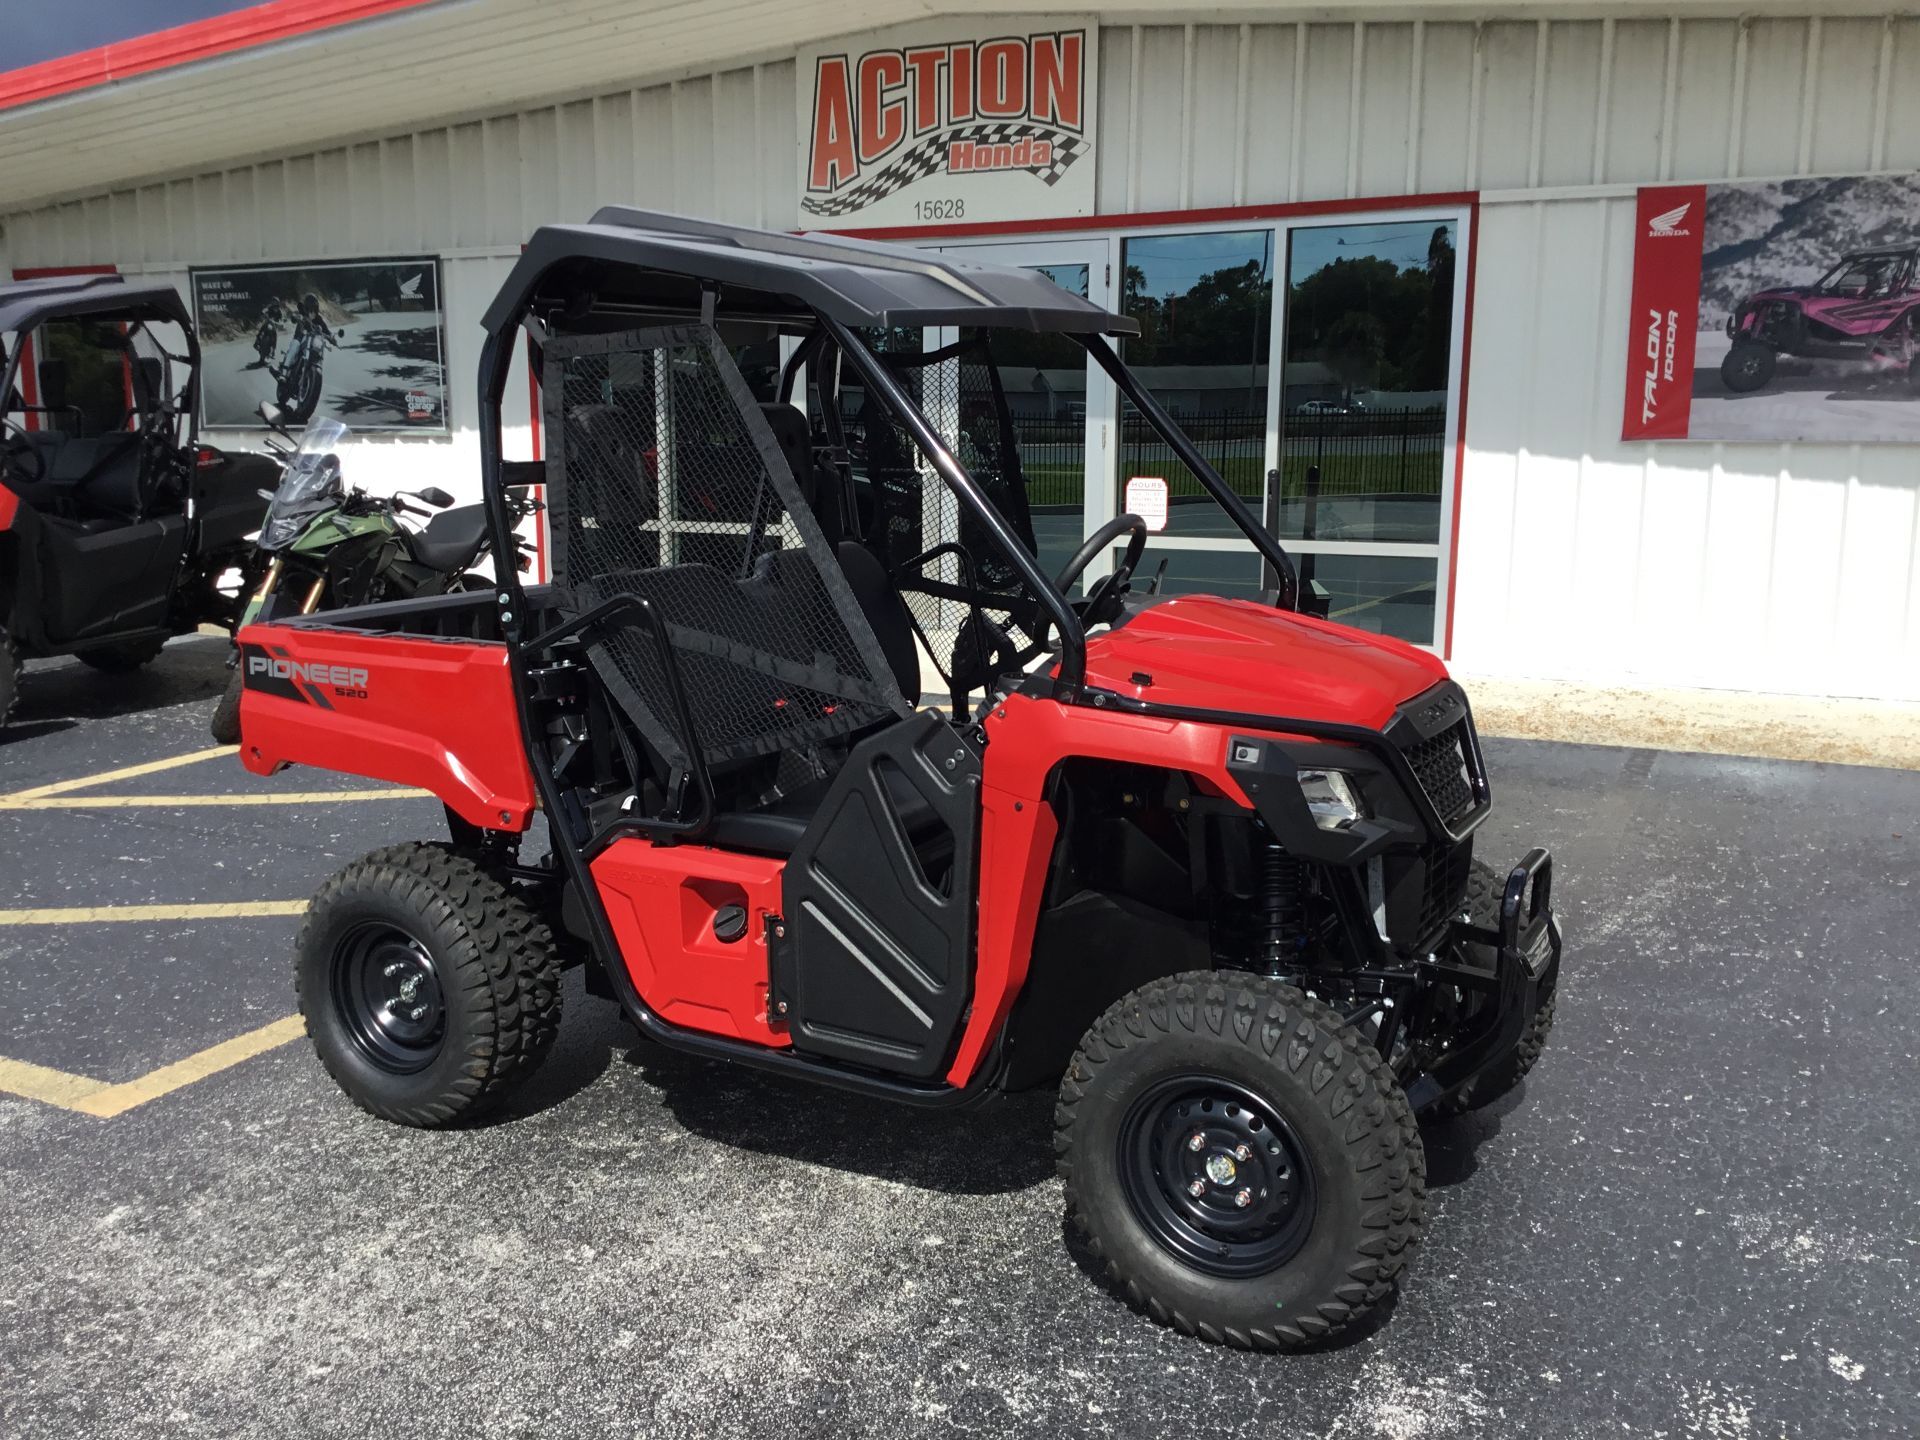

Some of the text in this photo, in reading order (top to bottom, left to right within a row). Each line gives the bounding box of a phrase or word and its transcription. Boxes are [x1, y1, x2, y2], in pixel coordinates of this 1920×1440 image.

[807, 29, 1086, 193] ACTION
[948, 135, 1053, 174] Honda
[914, 199, 965, 220] 15628
[1649, 229, 1690, 237] HONDA
[1664, 310, 1678, 382] 1000R
[1642, 309, 1661, 424] TALON
[1131, 481, 1163, 489] HOURS
[249, 656, 369, 688] PIONEER
[335, 687, 368, 699] 520
